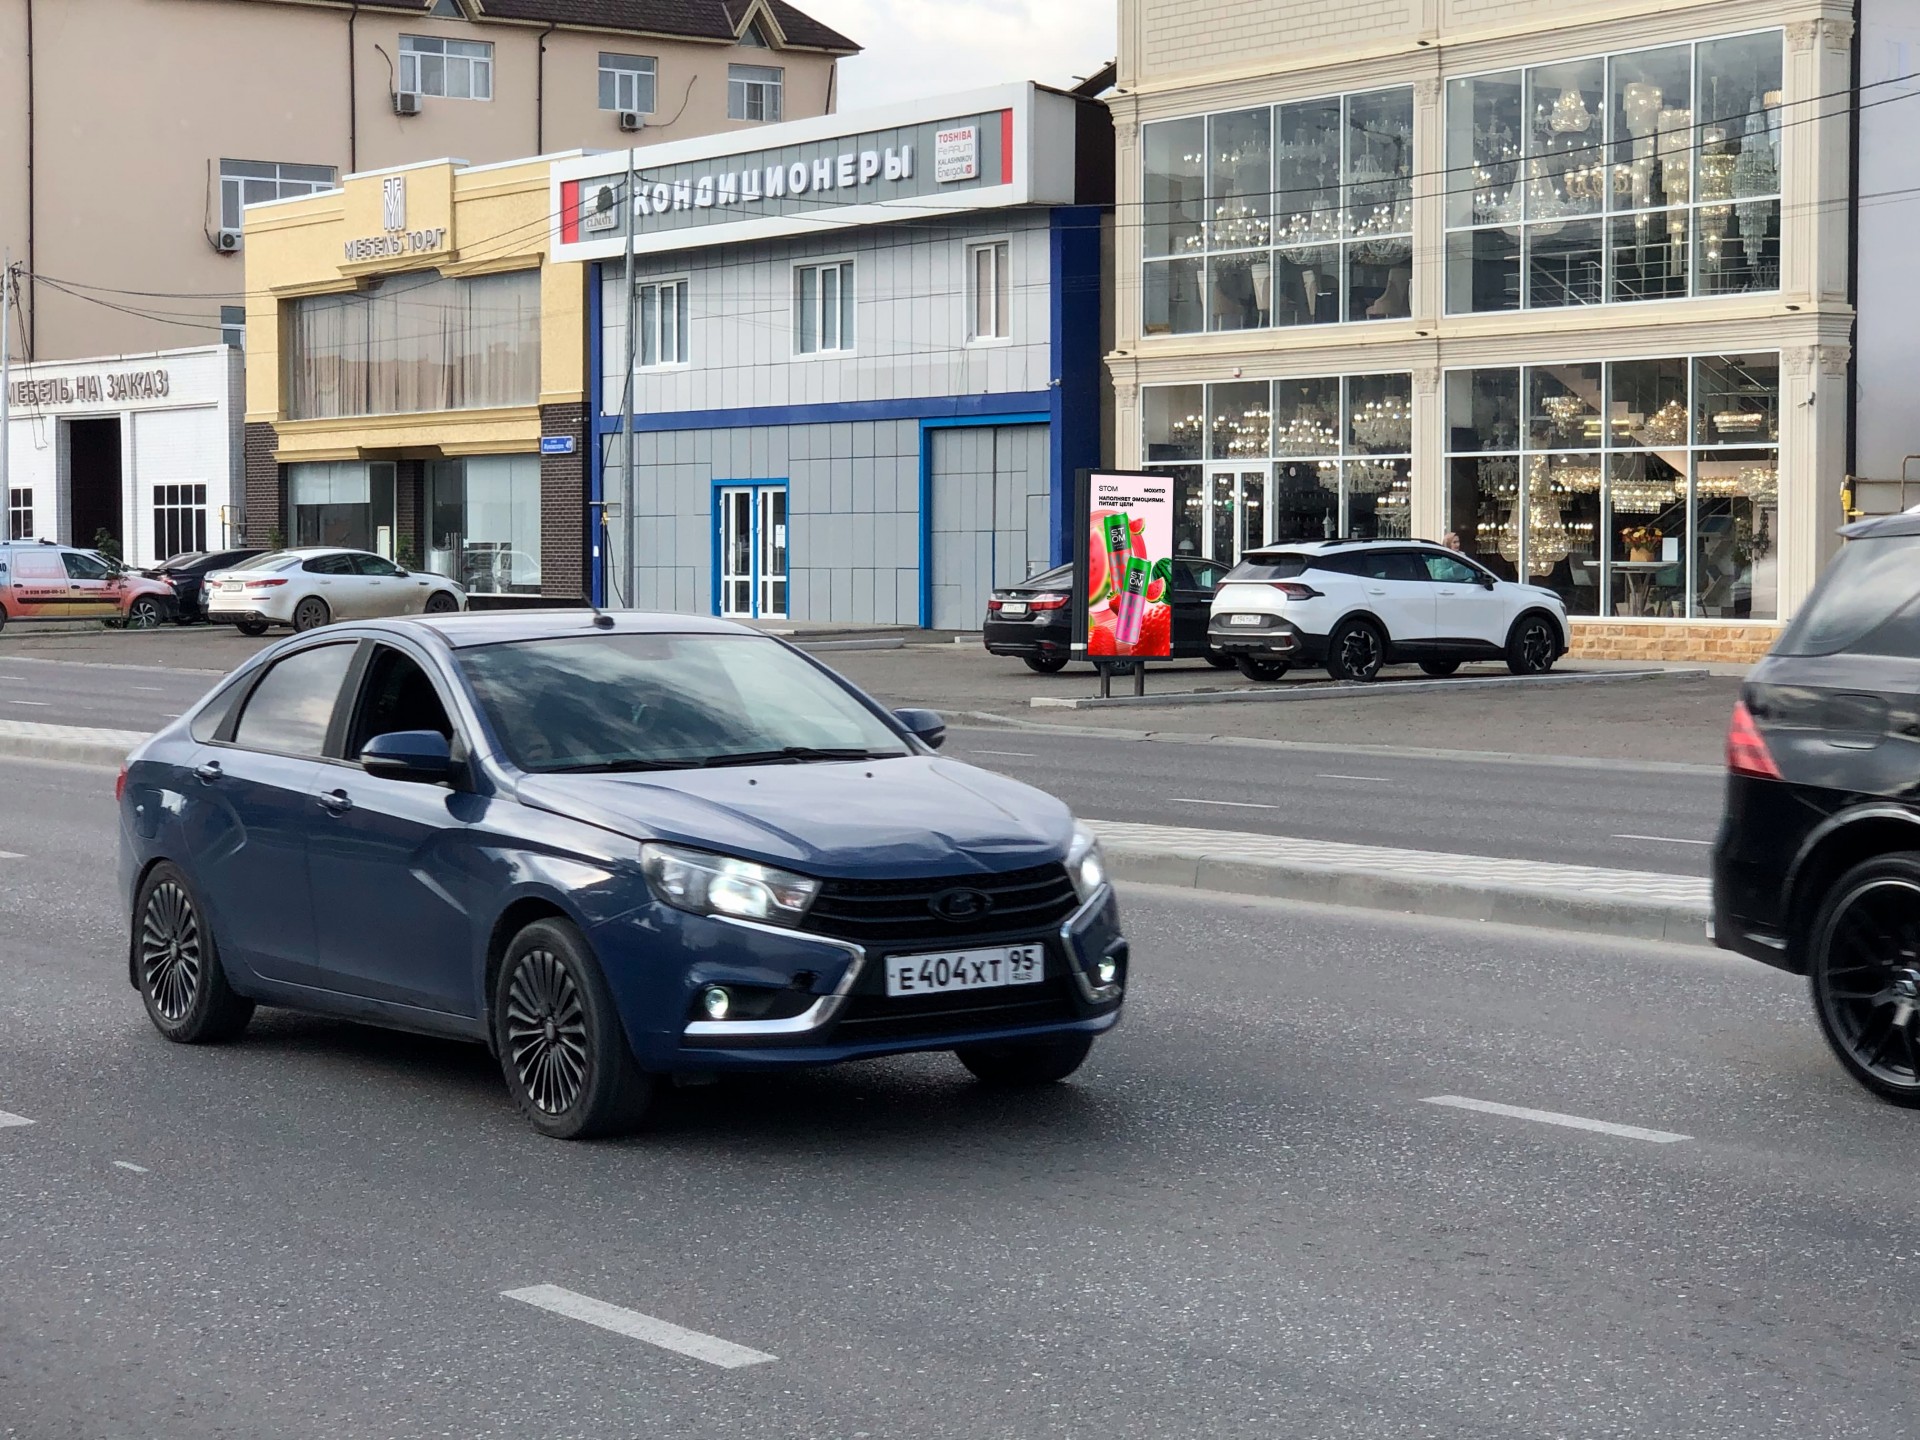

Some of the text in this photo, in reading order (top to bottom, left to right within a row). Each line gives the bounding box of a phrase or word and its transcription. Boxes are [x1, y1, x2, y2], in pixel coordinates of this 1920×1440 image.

[938, 130, 972, 143] TOSHIBA
[938, 155, 972, 166] KALASHNIKOV
[634, 145, 911, 215] КОНДИЦИОНЕРЫ
[586, 216, 612, 228] CLIMATE
[344, 228, 445, 260] МЕБЕЛЬ ТОРГ
[76, 375, 102, 401] НА
[107, 370, 168, 399] ЗАКАЗ
[1009, 949, 1035, 972] 95
[1012, 972, 1032, 981] RUS
